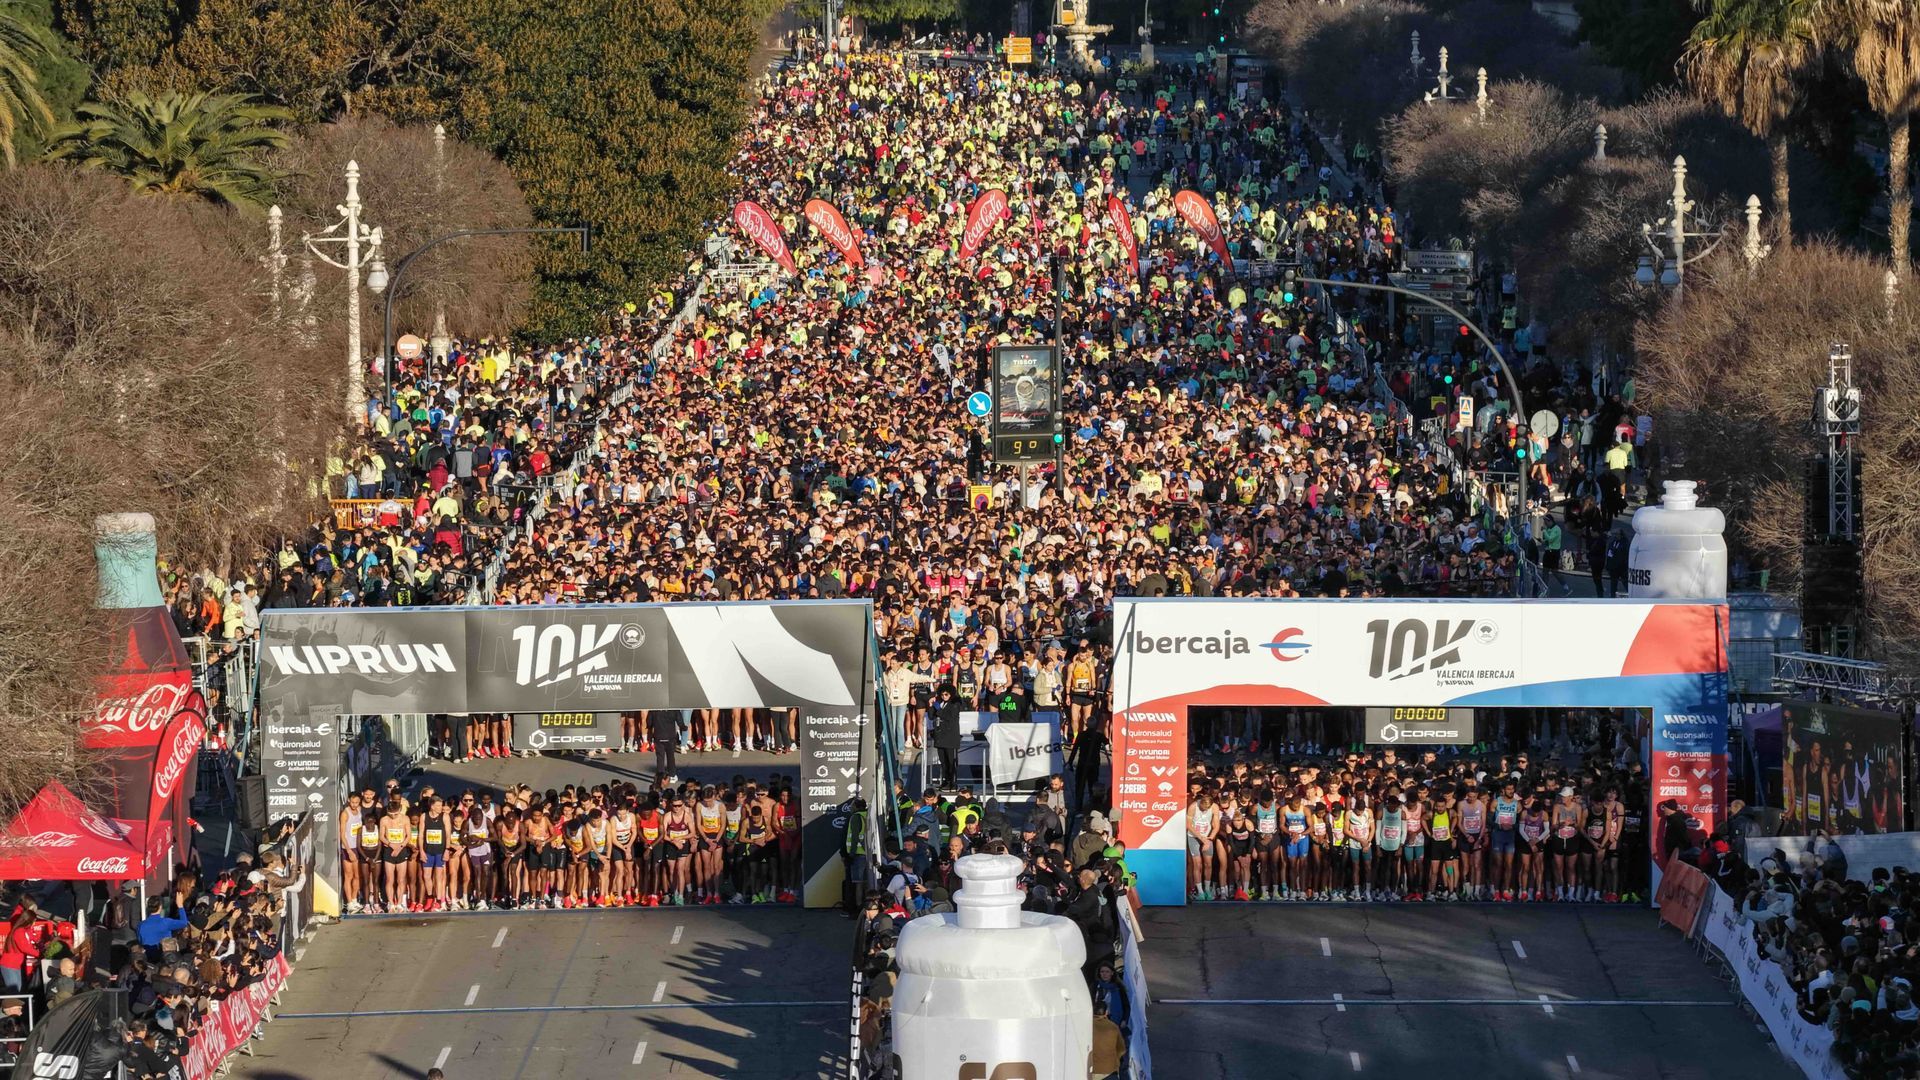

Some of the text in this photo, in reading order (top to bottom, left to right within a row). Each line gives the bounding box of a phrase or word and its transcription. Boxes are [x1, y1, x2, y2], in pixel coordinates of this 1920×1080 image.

[1366, 618, 1475, 681] 10K
[269, 643, 456, 675] KIPRUN
[512, 624, 622, 688] 10K
[584, 673, 662, 684] VALENCIA IBERCAJA
[1436, 670, 1515, 679] VALENCIA IBERCAJA
[541, 713, 593, 726] 0:00:00
[1394, 708, 1446, 720] 0:00:00
[1664, 714, 1718, 724] KIPRUN
[806, 715, 849, 726] Ibercaja
[268, 724, 311, 735] Ibercaja
[1401, 730, 1458, 738] COROS
[549, 735, 607, 743] COROS
[155, 716, 201, 798] Coca-Cola
[809, 786, 836, 796] 226ERS
[1119, 784, 1147, 794] 226ERS
[1660, 786, 1687, 796] 226ERS
[269, 795, 297, 806] 226ERS
[1119, 800, 1147, 809] divina
[810, 802, 837, 812] divina
[77, 857, 130, 873] Coca-Cola
